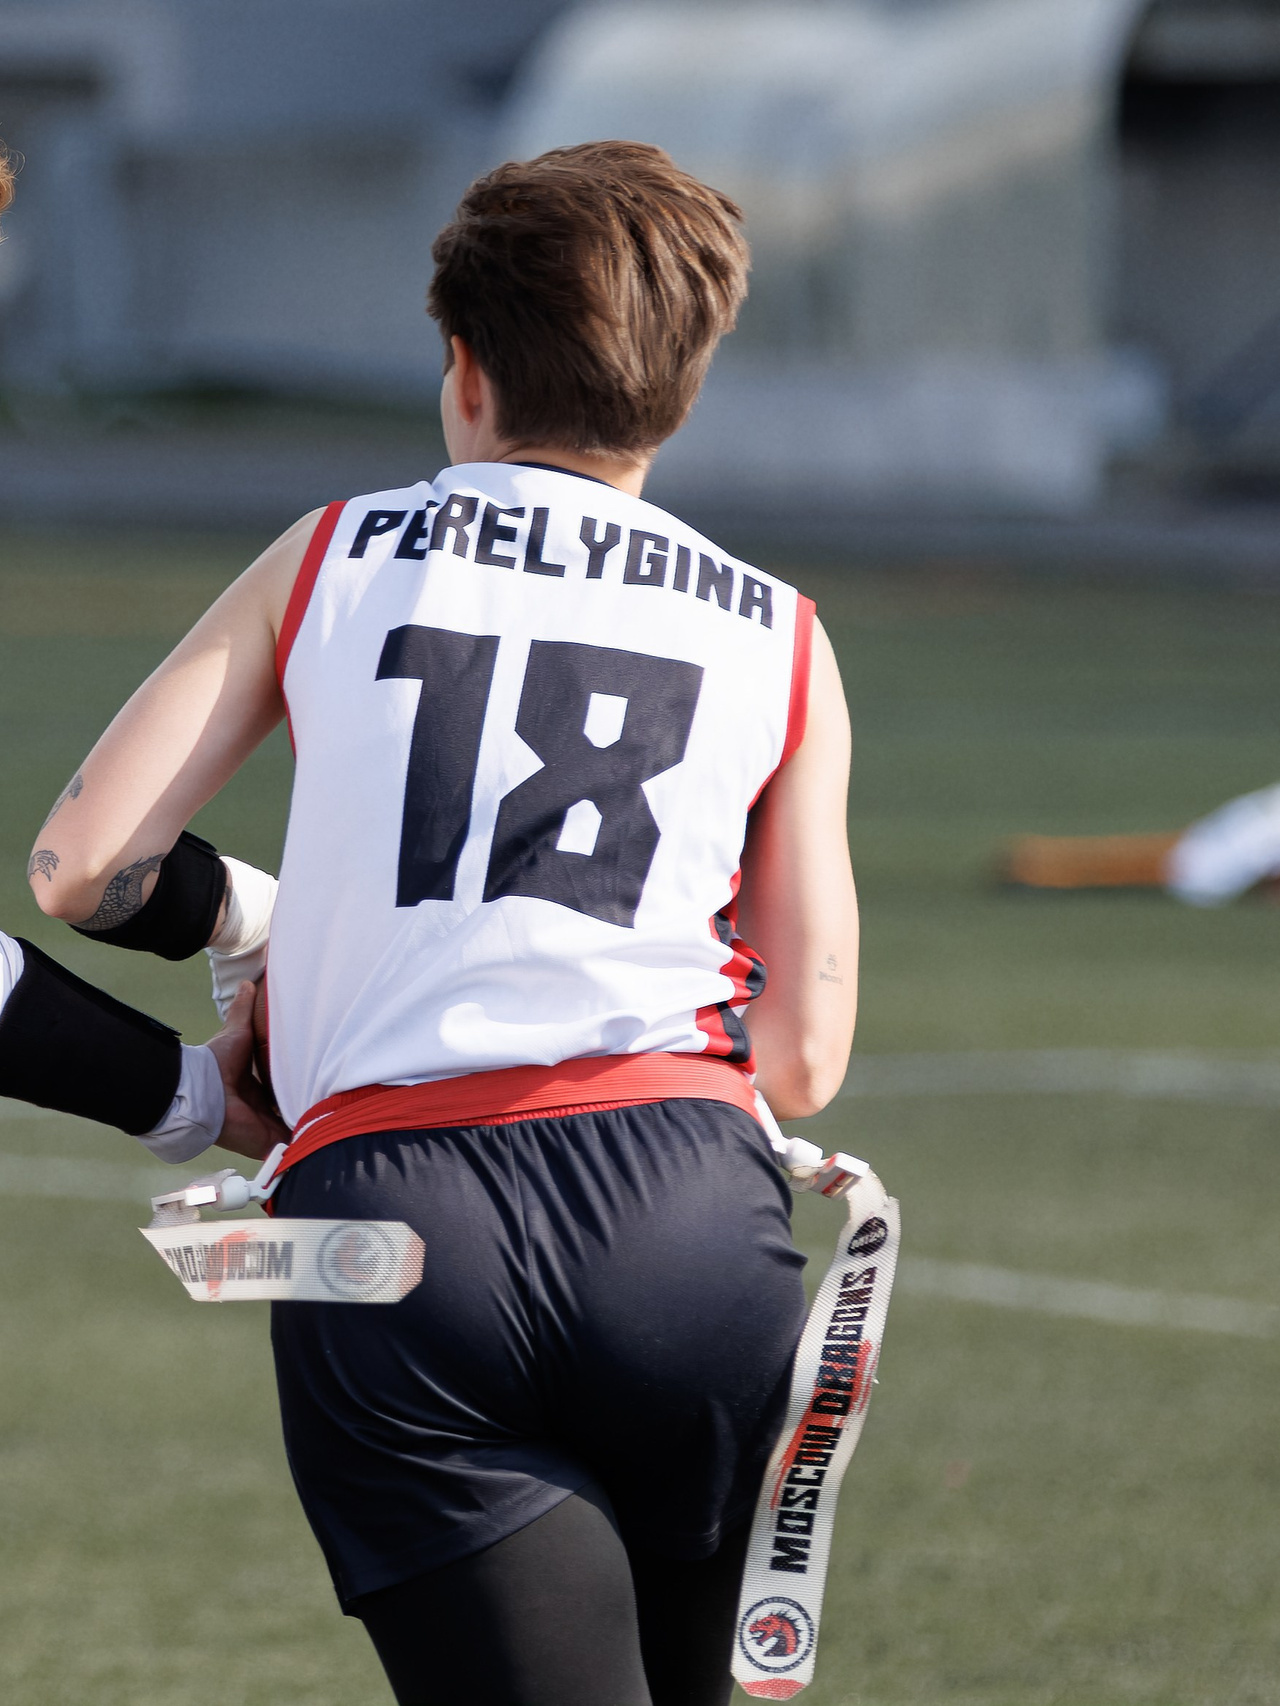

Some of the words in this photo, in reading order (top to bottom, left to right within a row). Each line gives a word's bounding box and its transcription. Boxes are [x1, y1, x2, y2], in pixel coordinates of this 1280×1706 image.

[348, 494, 773, 629] PERELYGINA
[375, 624, 704, 929] 18
[770, 1424, 842, 1573] MOSCOW
[813, 1266, 877, 1417] DRAGONS
